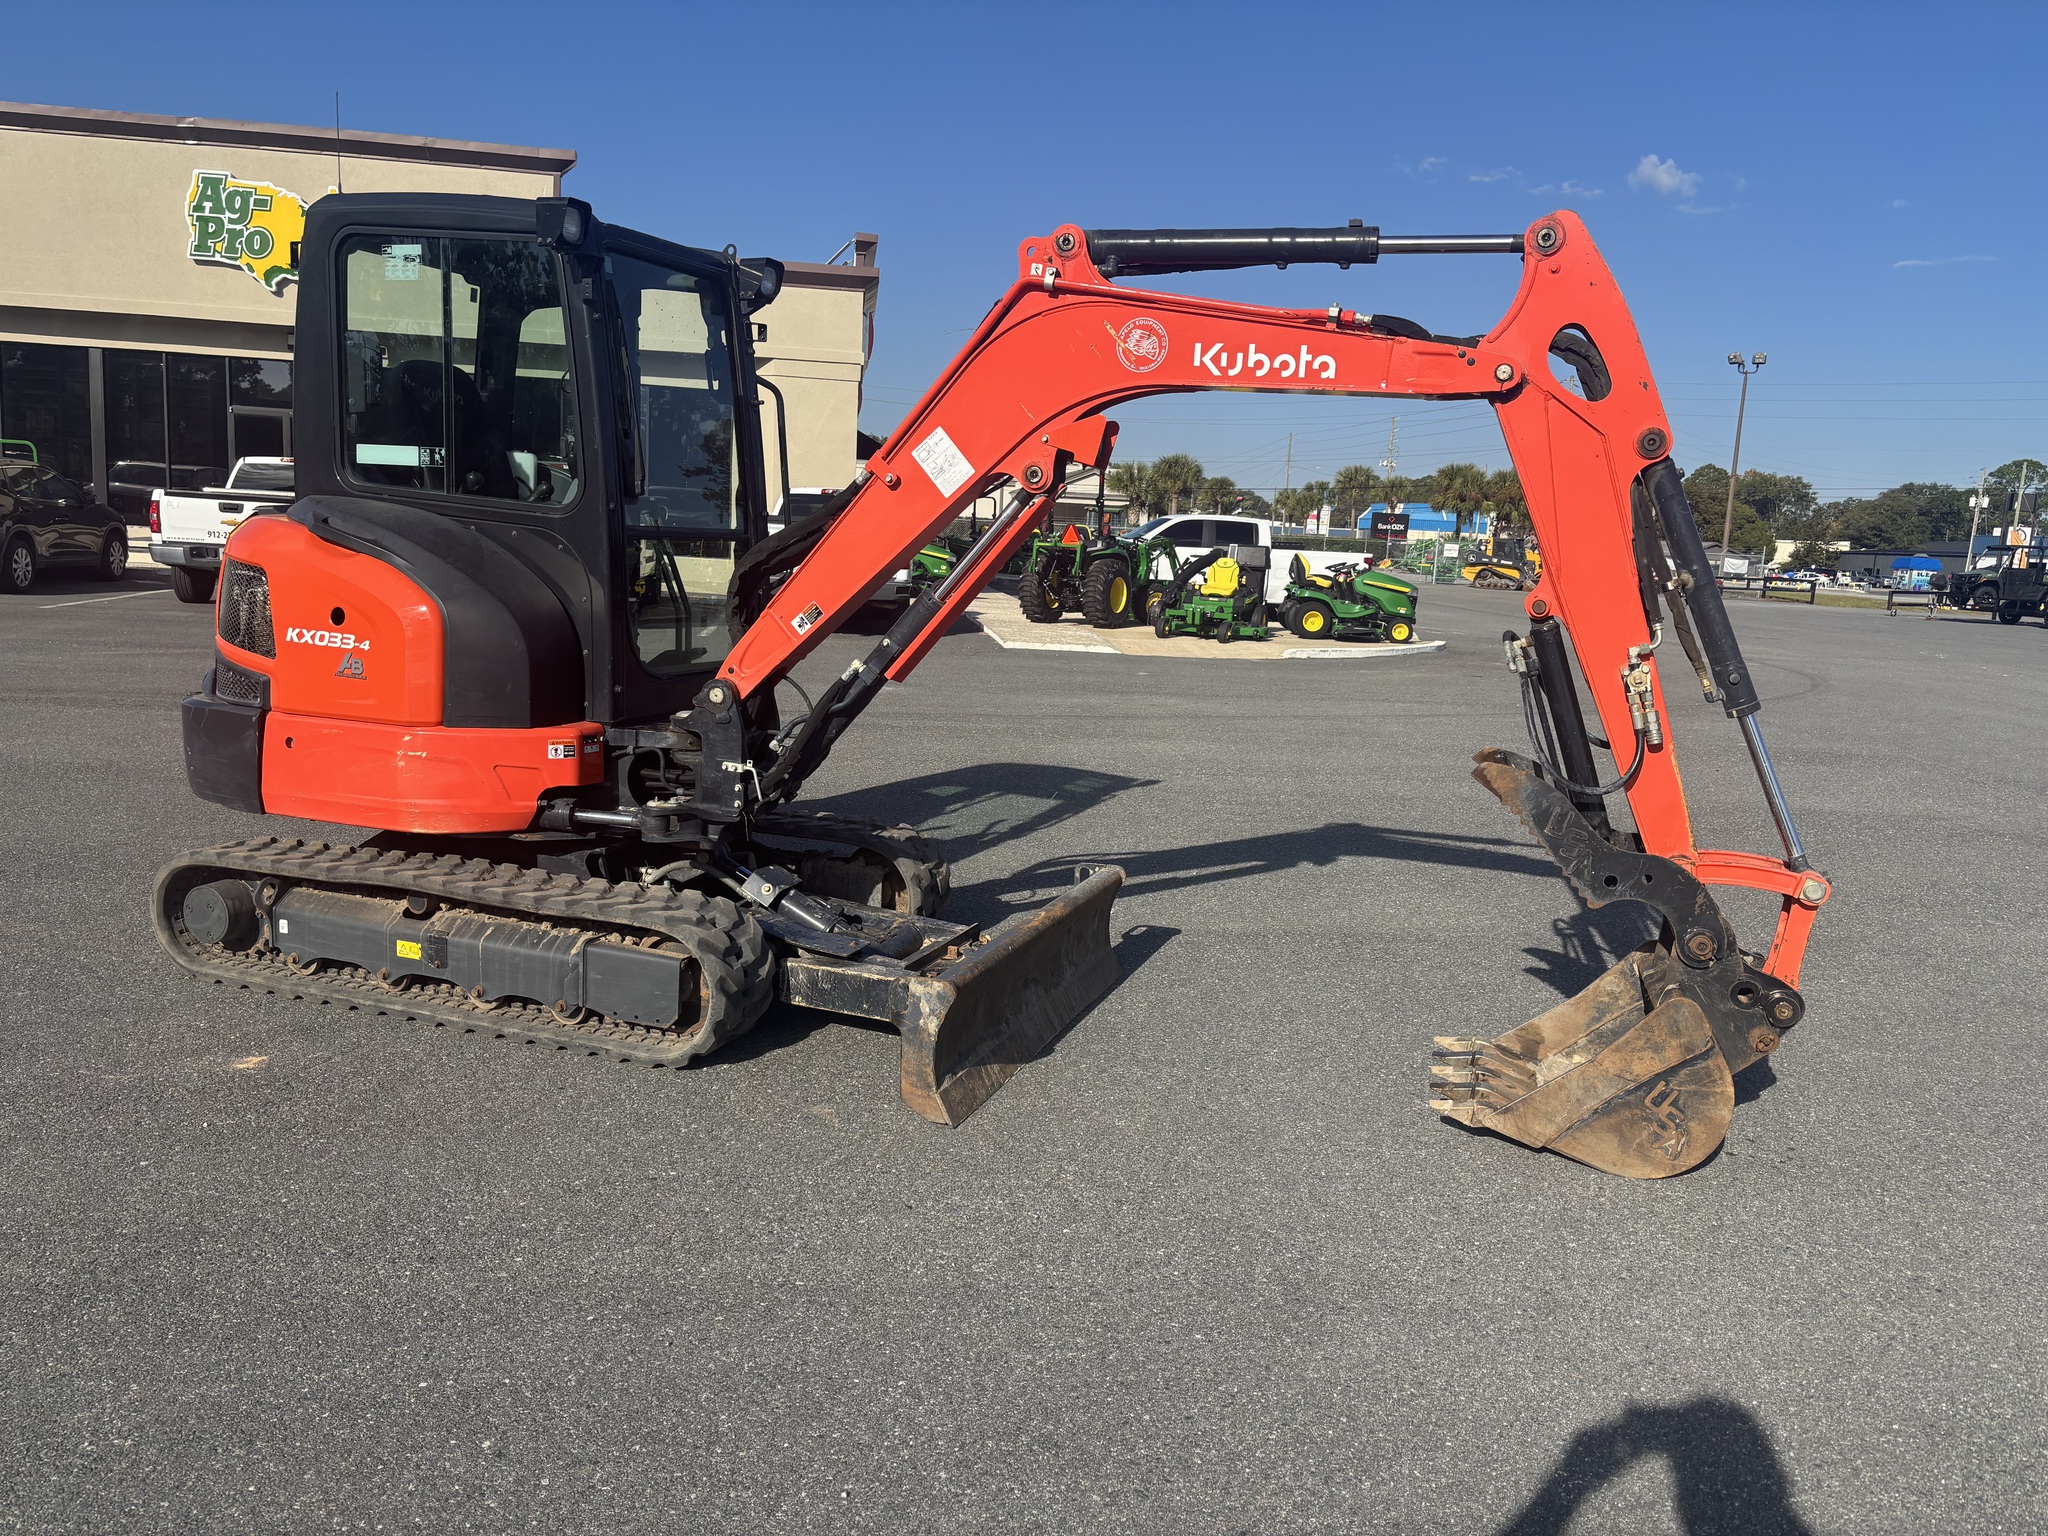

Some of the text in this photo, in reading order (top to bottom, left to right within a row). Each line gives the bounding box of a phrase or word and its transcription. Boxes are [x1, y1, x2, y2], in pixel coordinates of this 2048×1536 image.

[189, 172, 273, 226] Ag-
[190, 214, 274, 259] Pro
[1136, 320, 1165, 336] EQUIPMENT
[1193, 342, 1336, 379] Kubota
[286, 627, 371, 651] KX033-4
[1544, 806, 1593, 883] USA
[1643, 1080, 1687, 1162] USA
